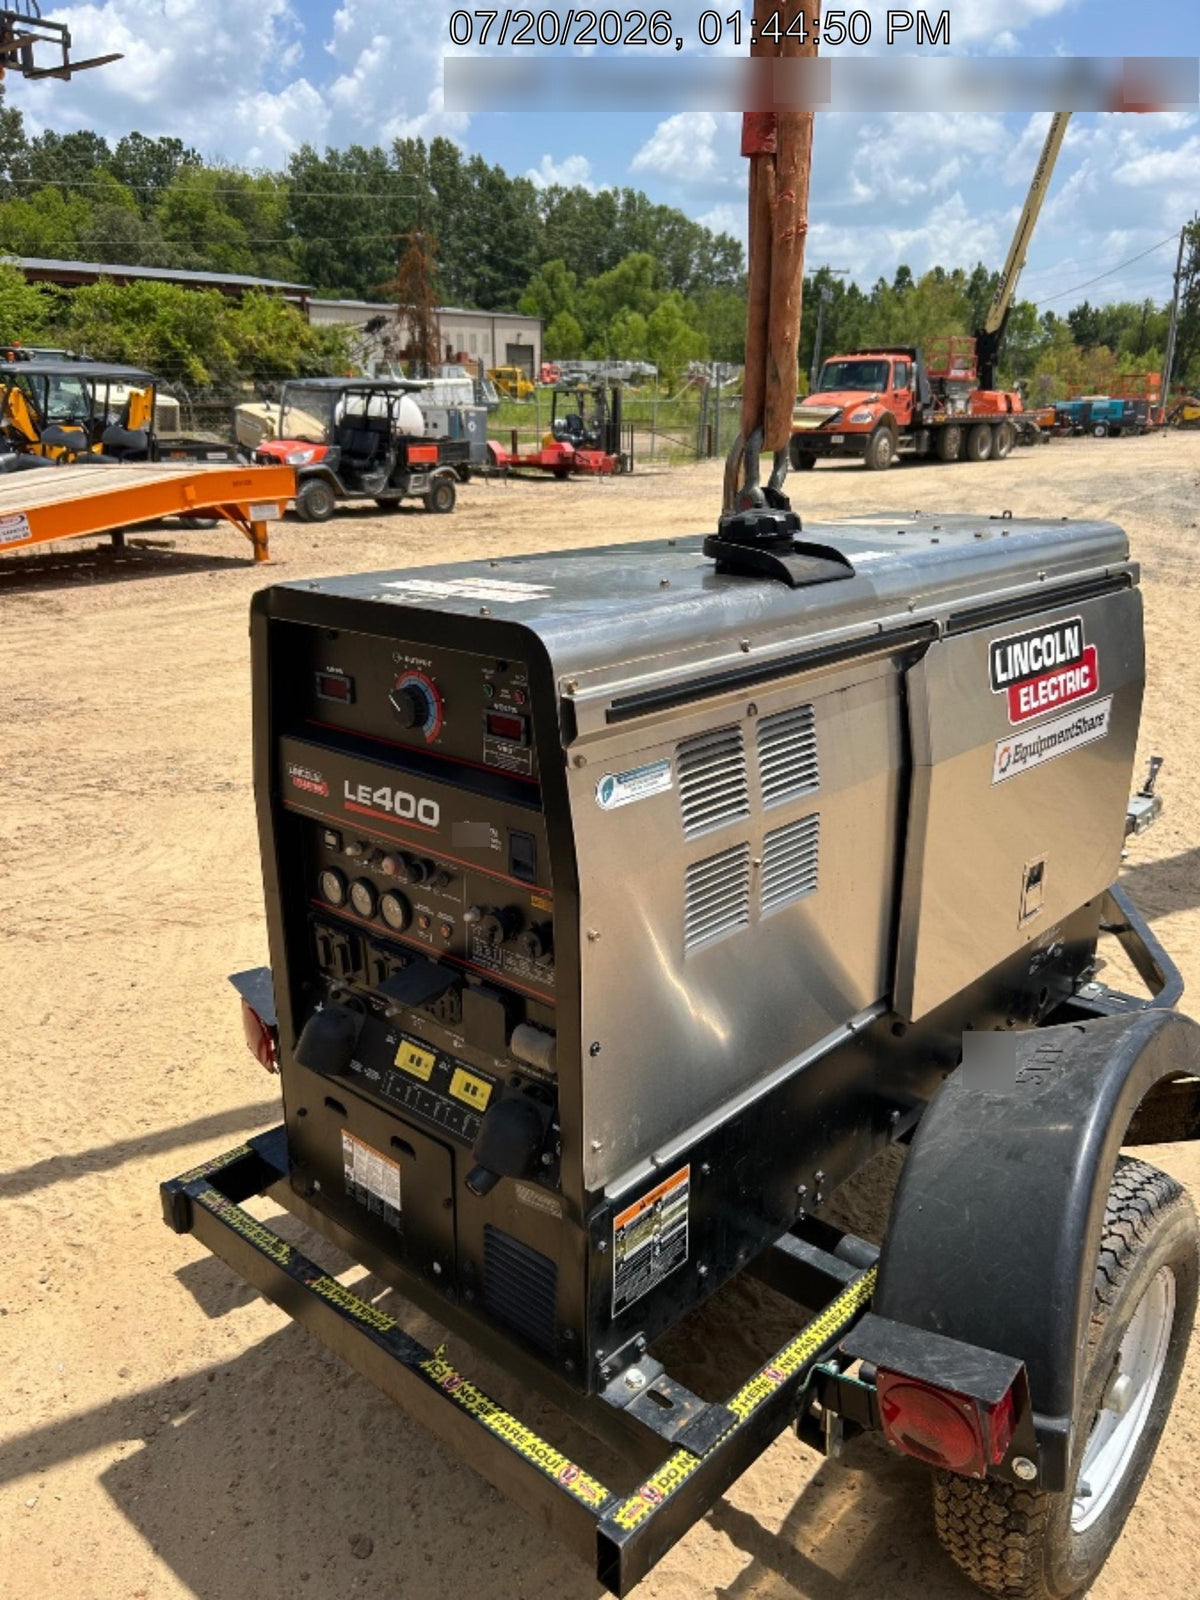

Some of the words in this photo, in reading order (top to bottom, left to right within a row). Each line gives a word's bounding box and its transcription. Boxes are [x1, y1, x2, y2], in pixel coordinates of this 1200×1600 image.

[995, 625, 1080, 683] LINCOLN
[1019, 665, 1090, 713] ELECTRIC
[1012, 711, 1105, 765] EquipmentShare
[344, 780, 440, 827] LE400
[740, 1378, 770, 1407] HERE
[779, 1353, 797, 1370] NE
[793, 1334, 817, 1356] PAS
[813, 1307, 845, 1336] TENEZ
[457, 1387, 477, 1404] NO
[475, 1403, 496, 1418] SE
[493, 1415, 528, 1445] PARE
[658, 1467, 679, 1488] DO
